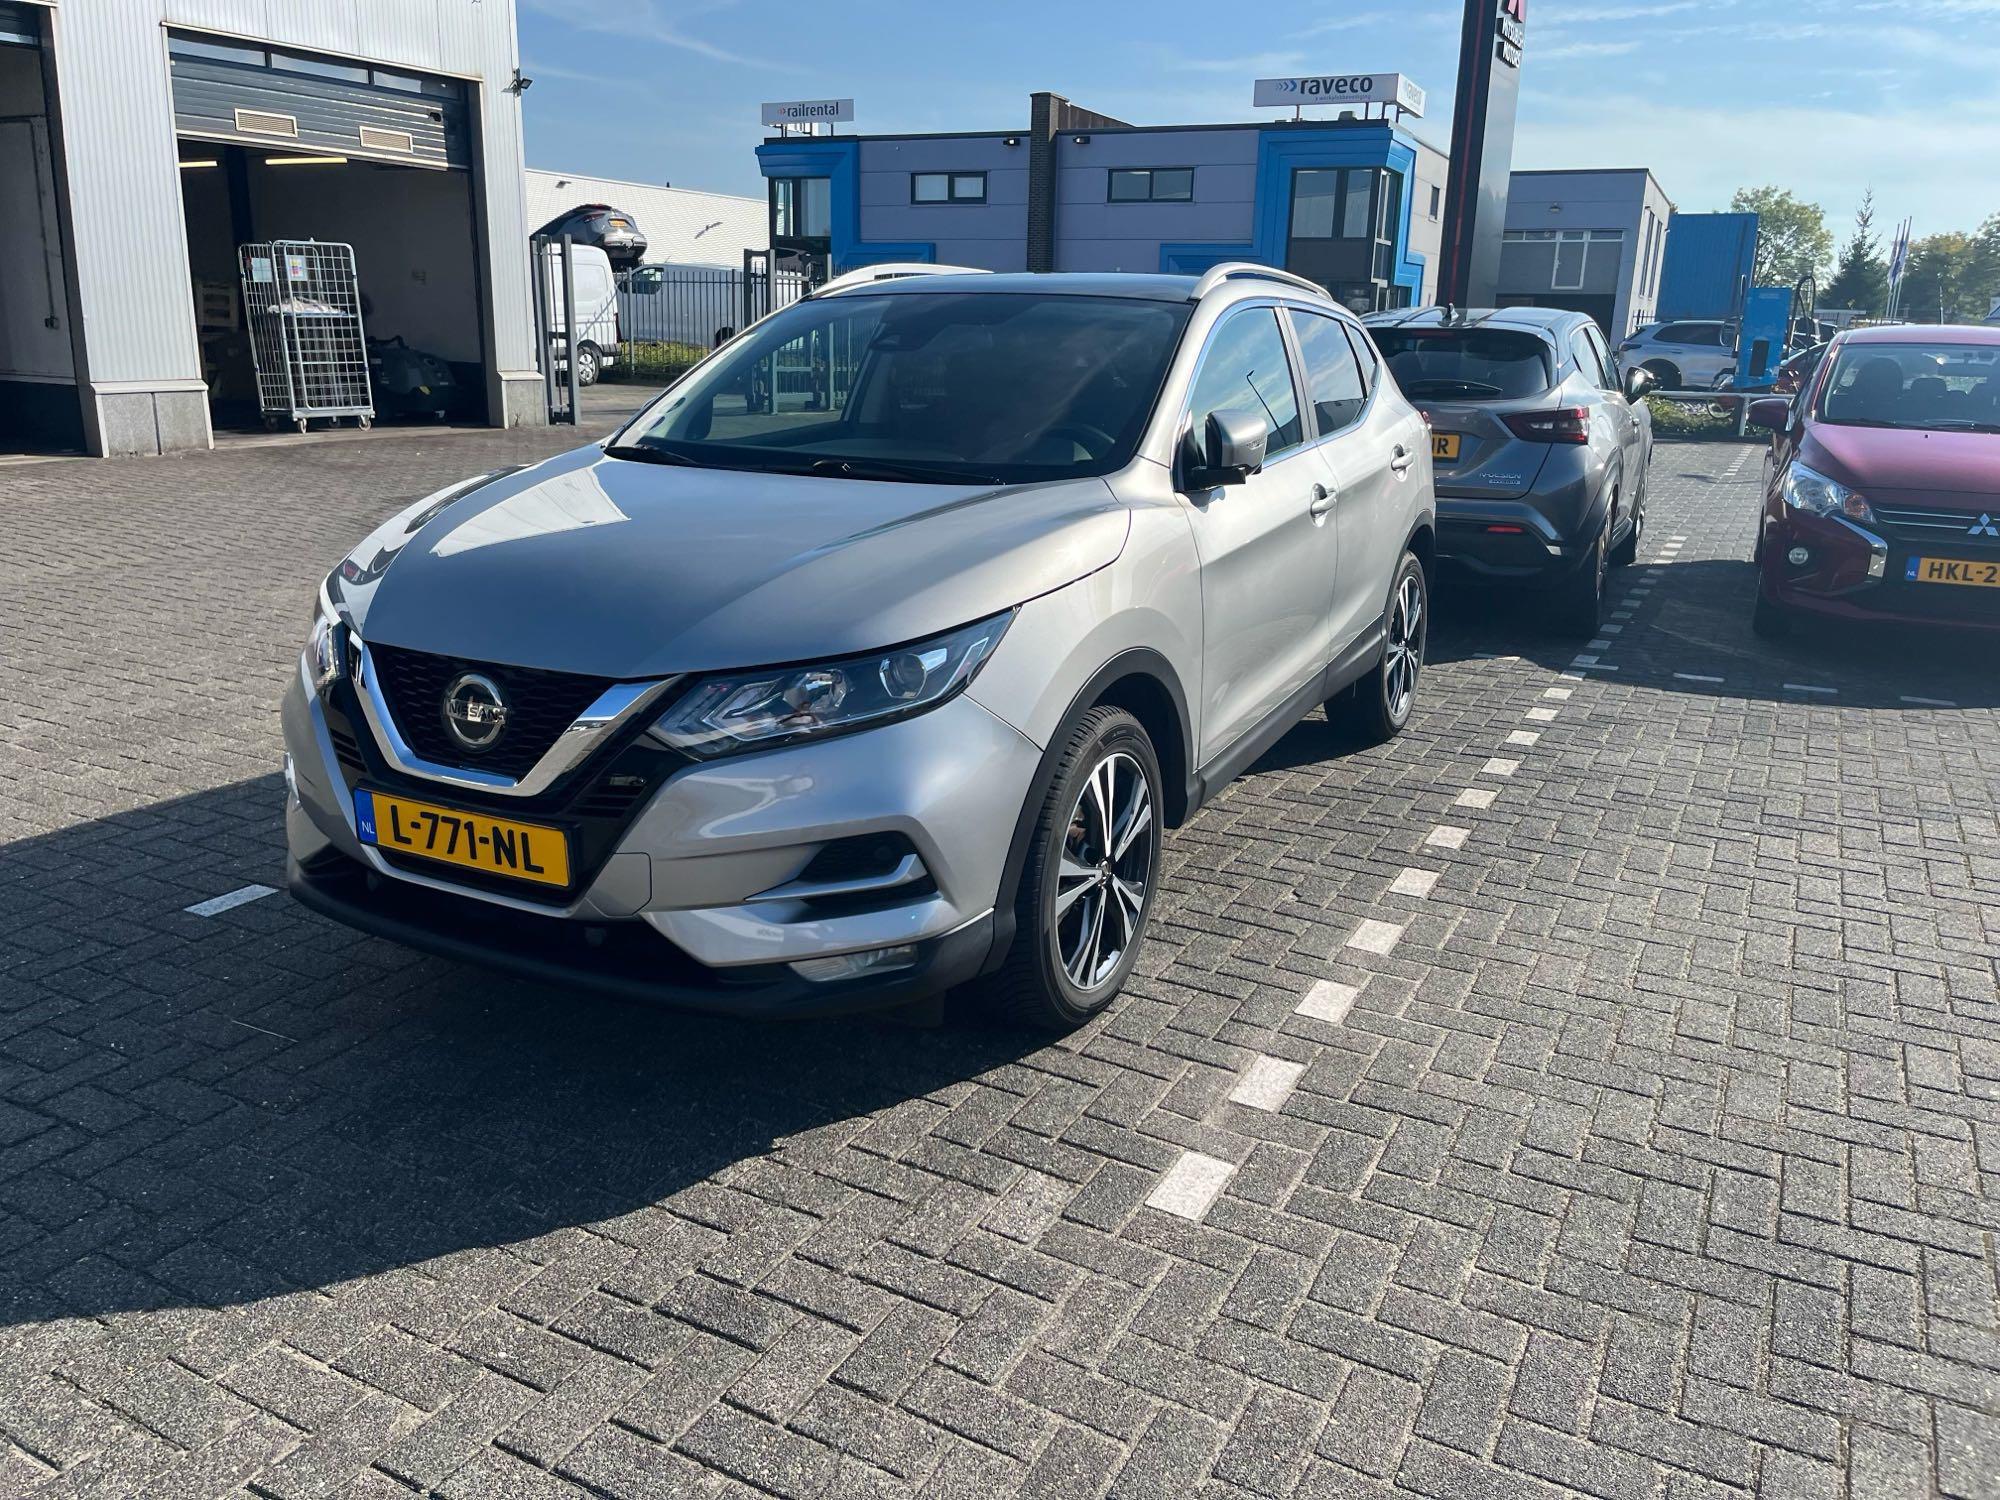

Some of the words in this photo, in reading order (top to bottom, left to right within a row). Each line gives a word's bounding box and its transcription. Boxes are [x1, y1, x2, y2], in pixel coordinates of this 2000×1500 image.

[1300, 77, 1373, 95] raveco
[787, 102, 839, 117] railrental
[1928, 561, 1998, 583] HKL-2
[361, 820, 375, 834] NL
[390, 805, 545, 875] L-771-NL
